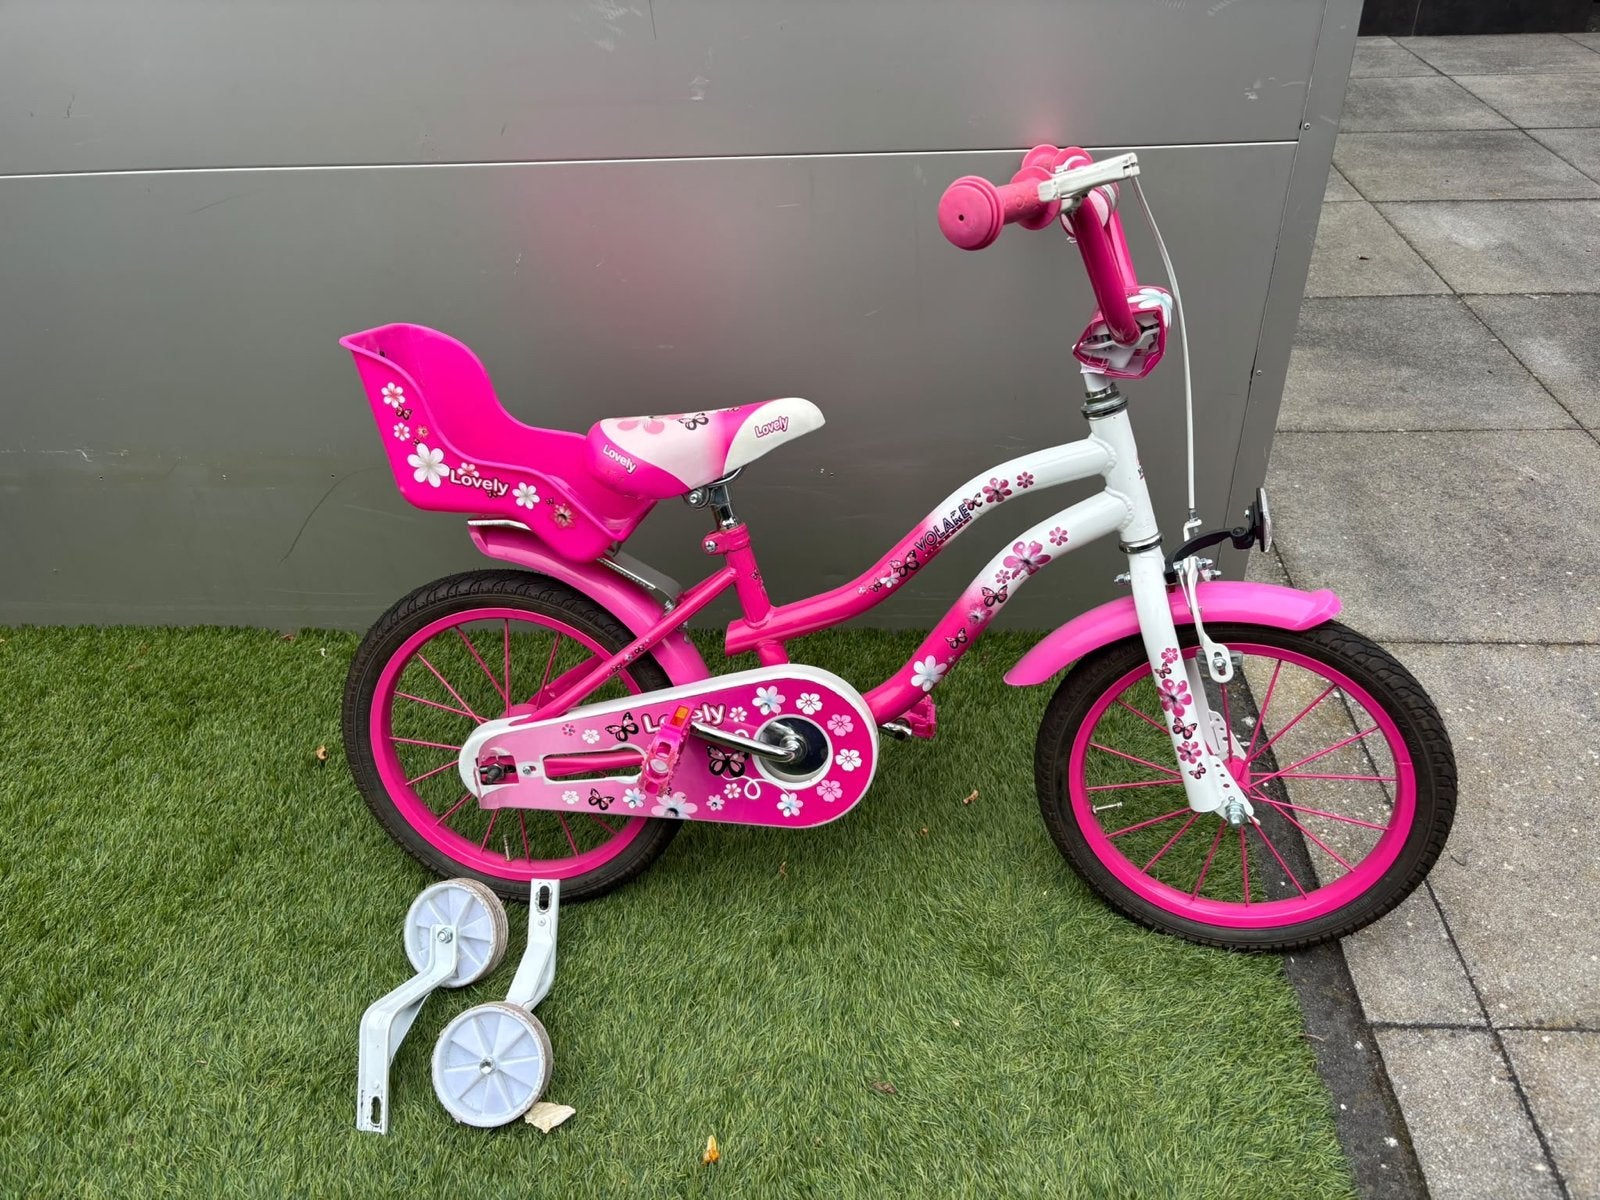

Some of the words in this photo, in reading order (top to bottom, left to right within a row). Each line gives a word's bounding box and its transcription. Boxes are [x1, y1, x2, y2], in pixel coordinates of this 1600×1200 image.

[754, 416, 789, 438] Lovely
[603, 444, 637, 474] Lovely
[449, 469, 510, 497] Lovely
[641, 702, 726, 734] Lely
